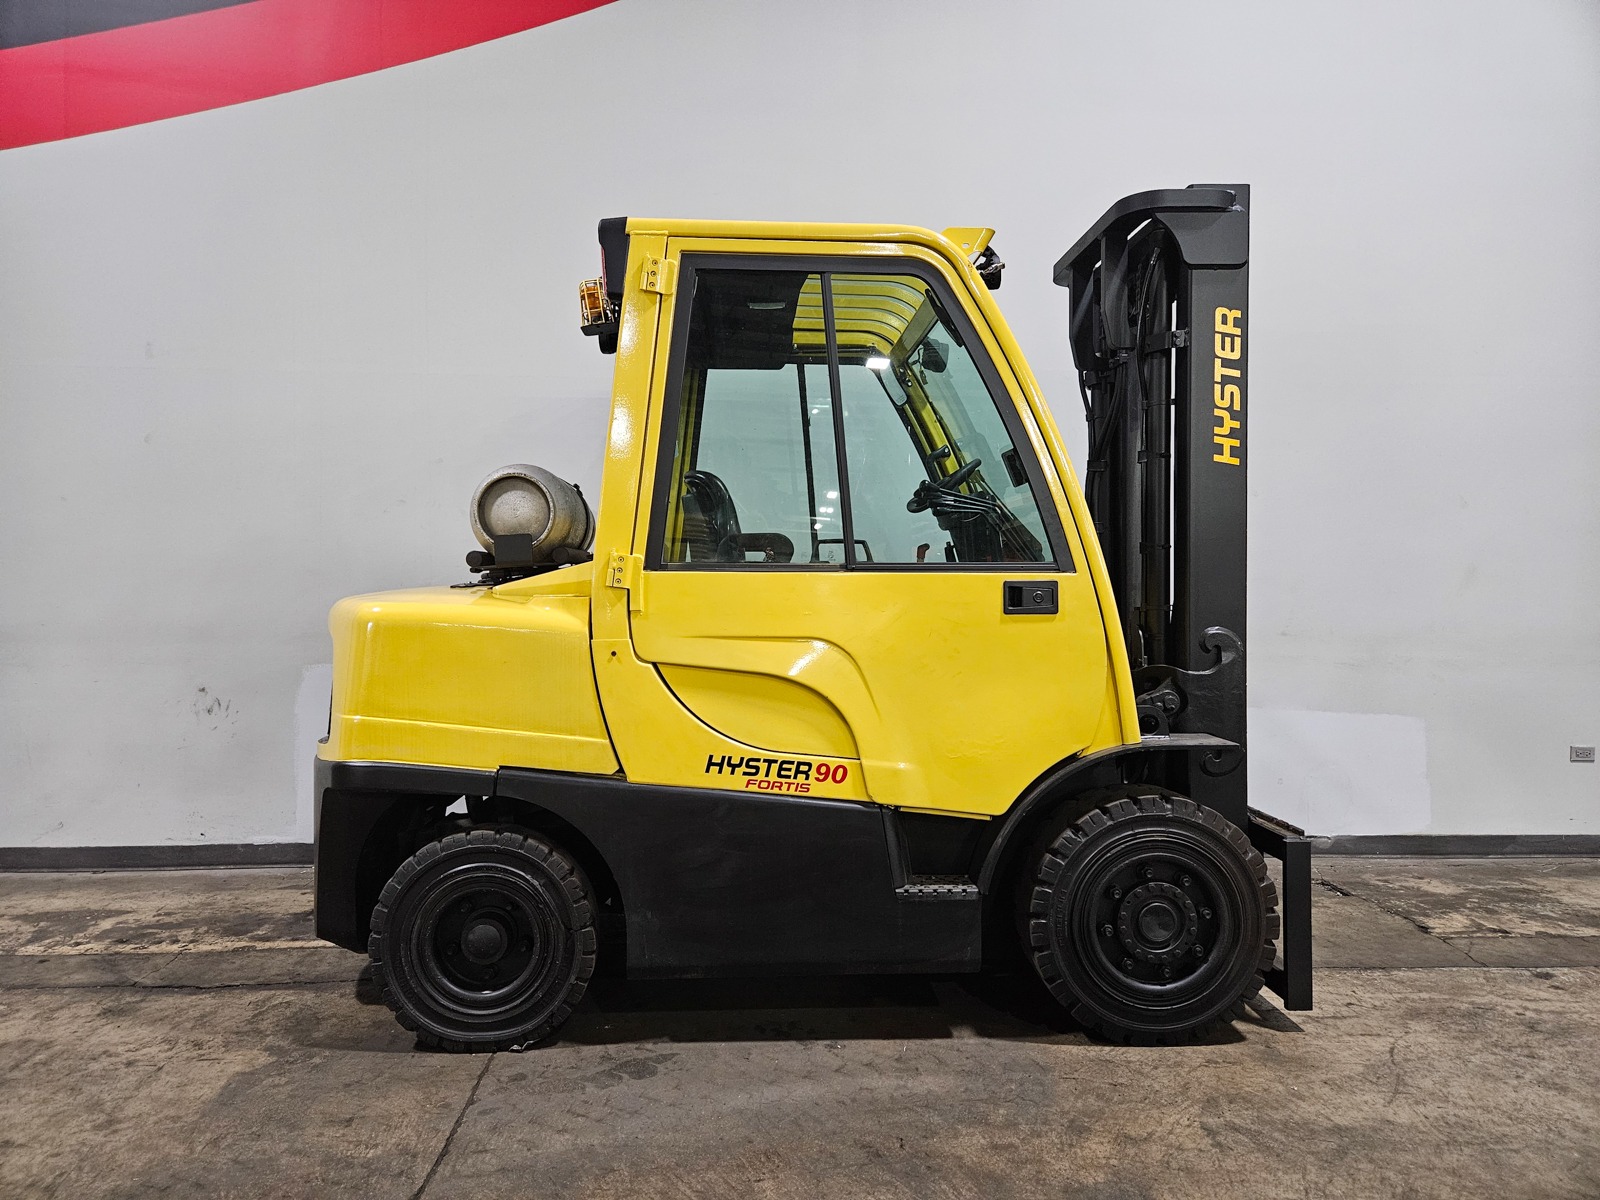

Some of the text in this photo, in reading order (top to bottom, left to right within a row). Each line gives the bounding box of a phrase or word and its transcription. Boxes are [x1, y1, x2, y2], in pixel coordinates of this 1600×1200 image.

[1213, 306, 1242, 466] HYSTER
[705, 754, 848, 784] HYSTER 90
[745, 779, 811, 793] FORTIS
